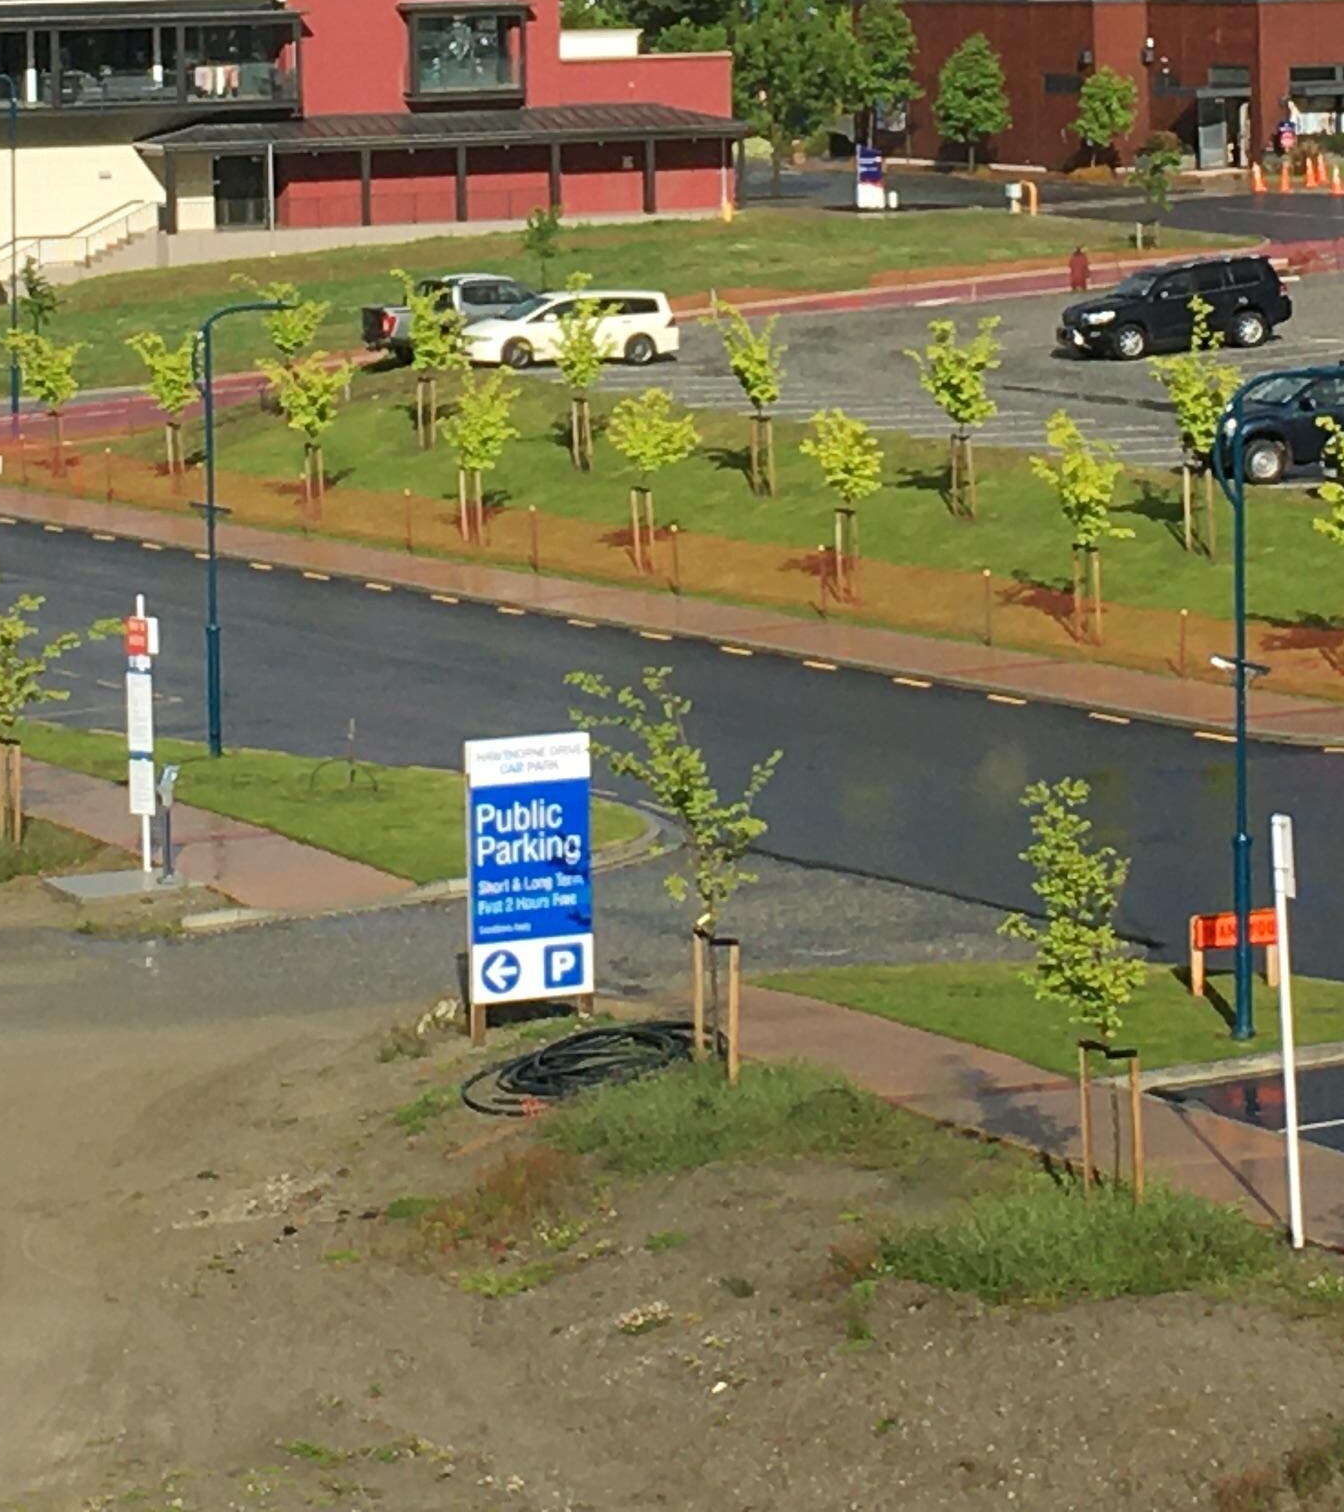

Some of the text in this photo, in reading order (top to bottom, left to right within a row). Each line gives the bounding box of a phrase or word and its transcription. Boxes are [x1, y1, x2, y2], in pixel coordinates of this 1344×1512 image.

[476, 798, 563, 834] Public
[477, 831, 581, 867] Parking
[478, 878, 510, 896] Short
[523, 876, 553, 891] Long
[505, 897, 514, 912] 2
[516, 896, 550, 911] Hours
[552, 951, 575, 982] P
